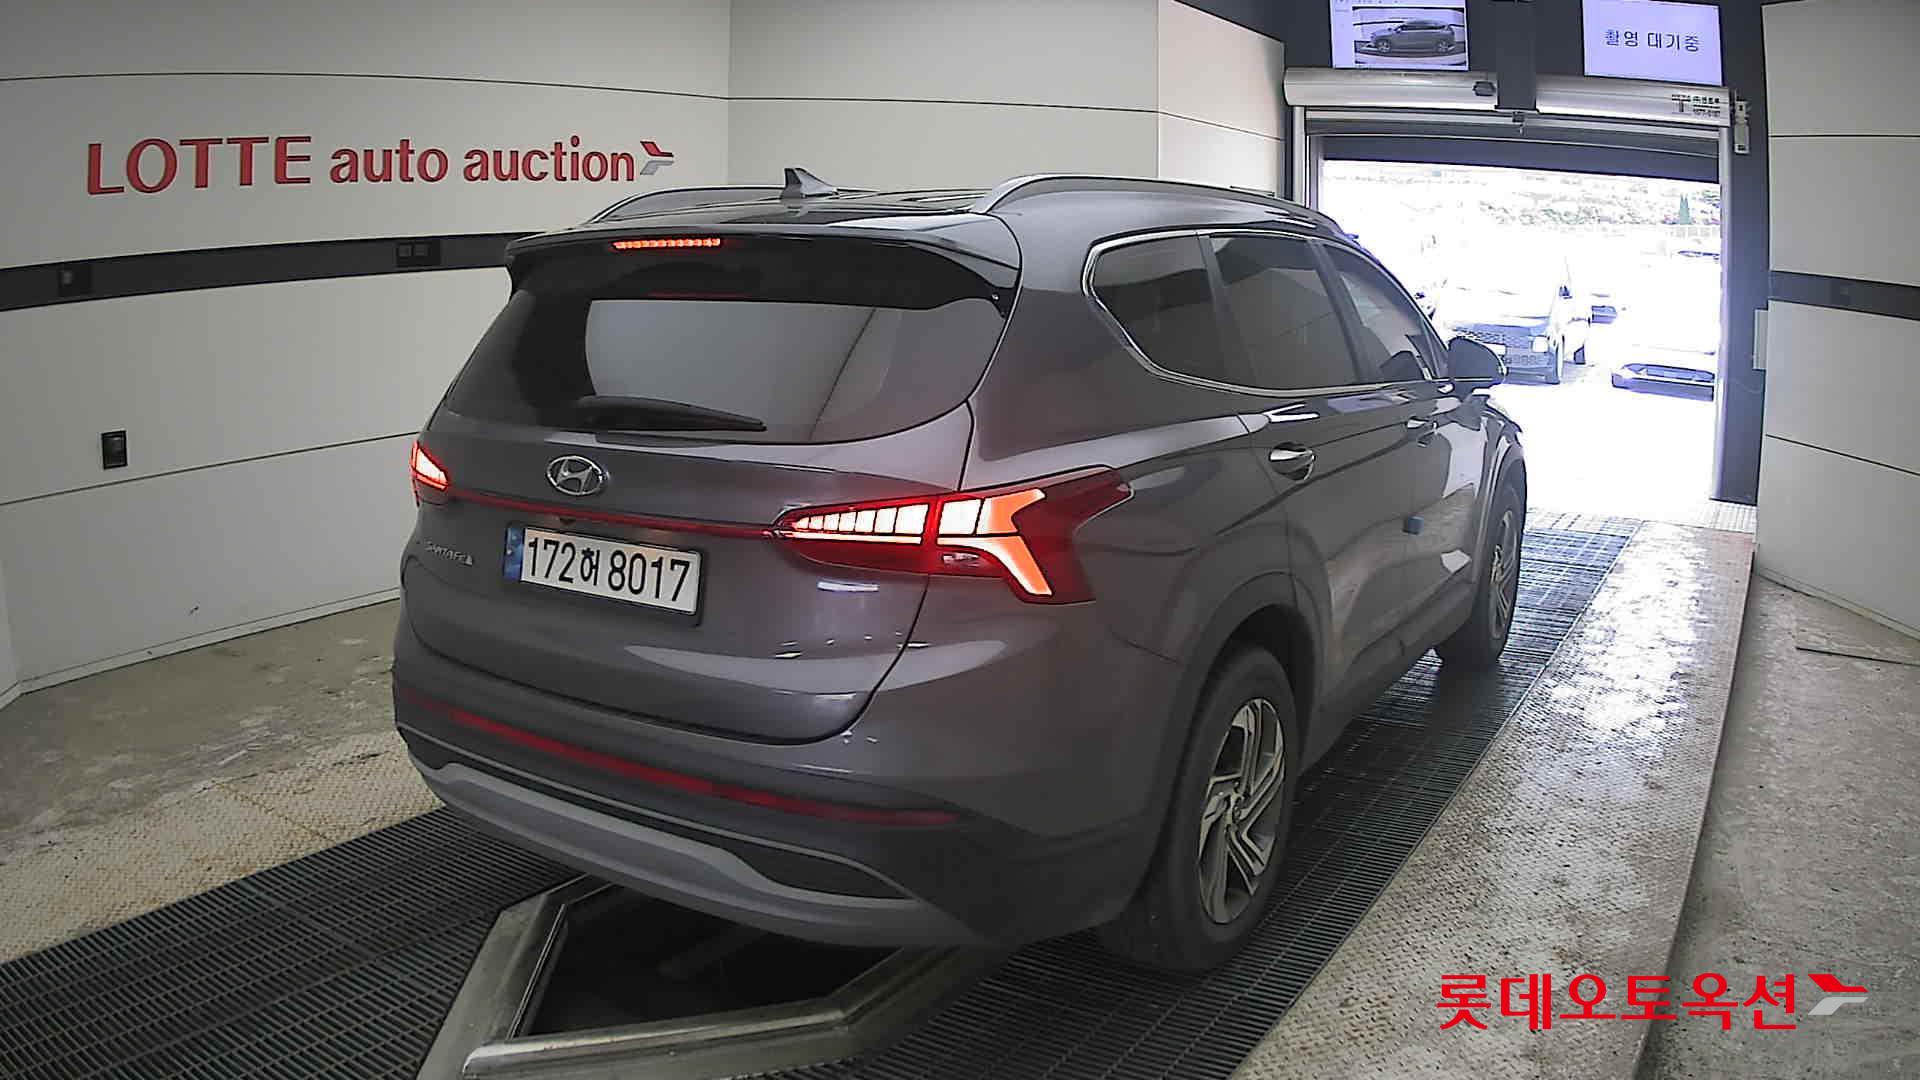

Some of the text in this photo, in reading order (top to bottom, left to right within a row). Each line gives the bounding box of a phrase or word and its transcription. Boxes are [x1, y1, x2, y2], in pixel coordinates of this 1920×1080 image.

[1605, 29, 1699, 52] 촬영 대기중
[87, 135, 635, 195] LOTTE auto auction
